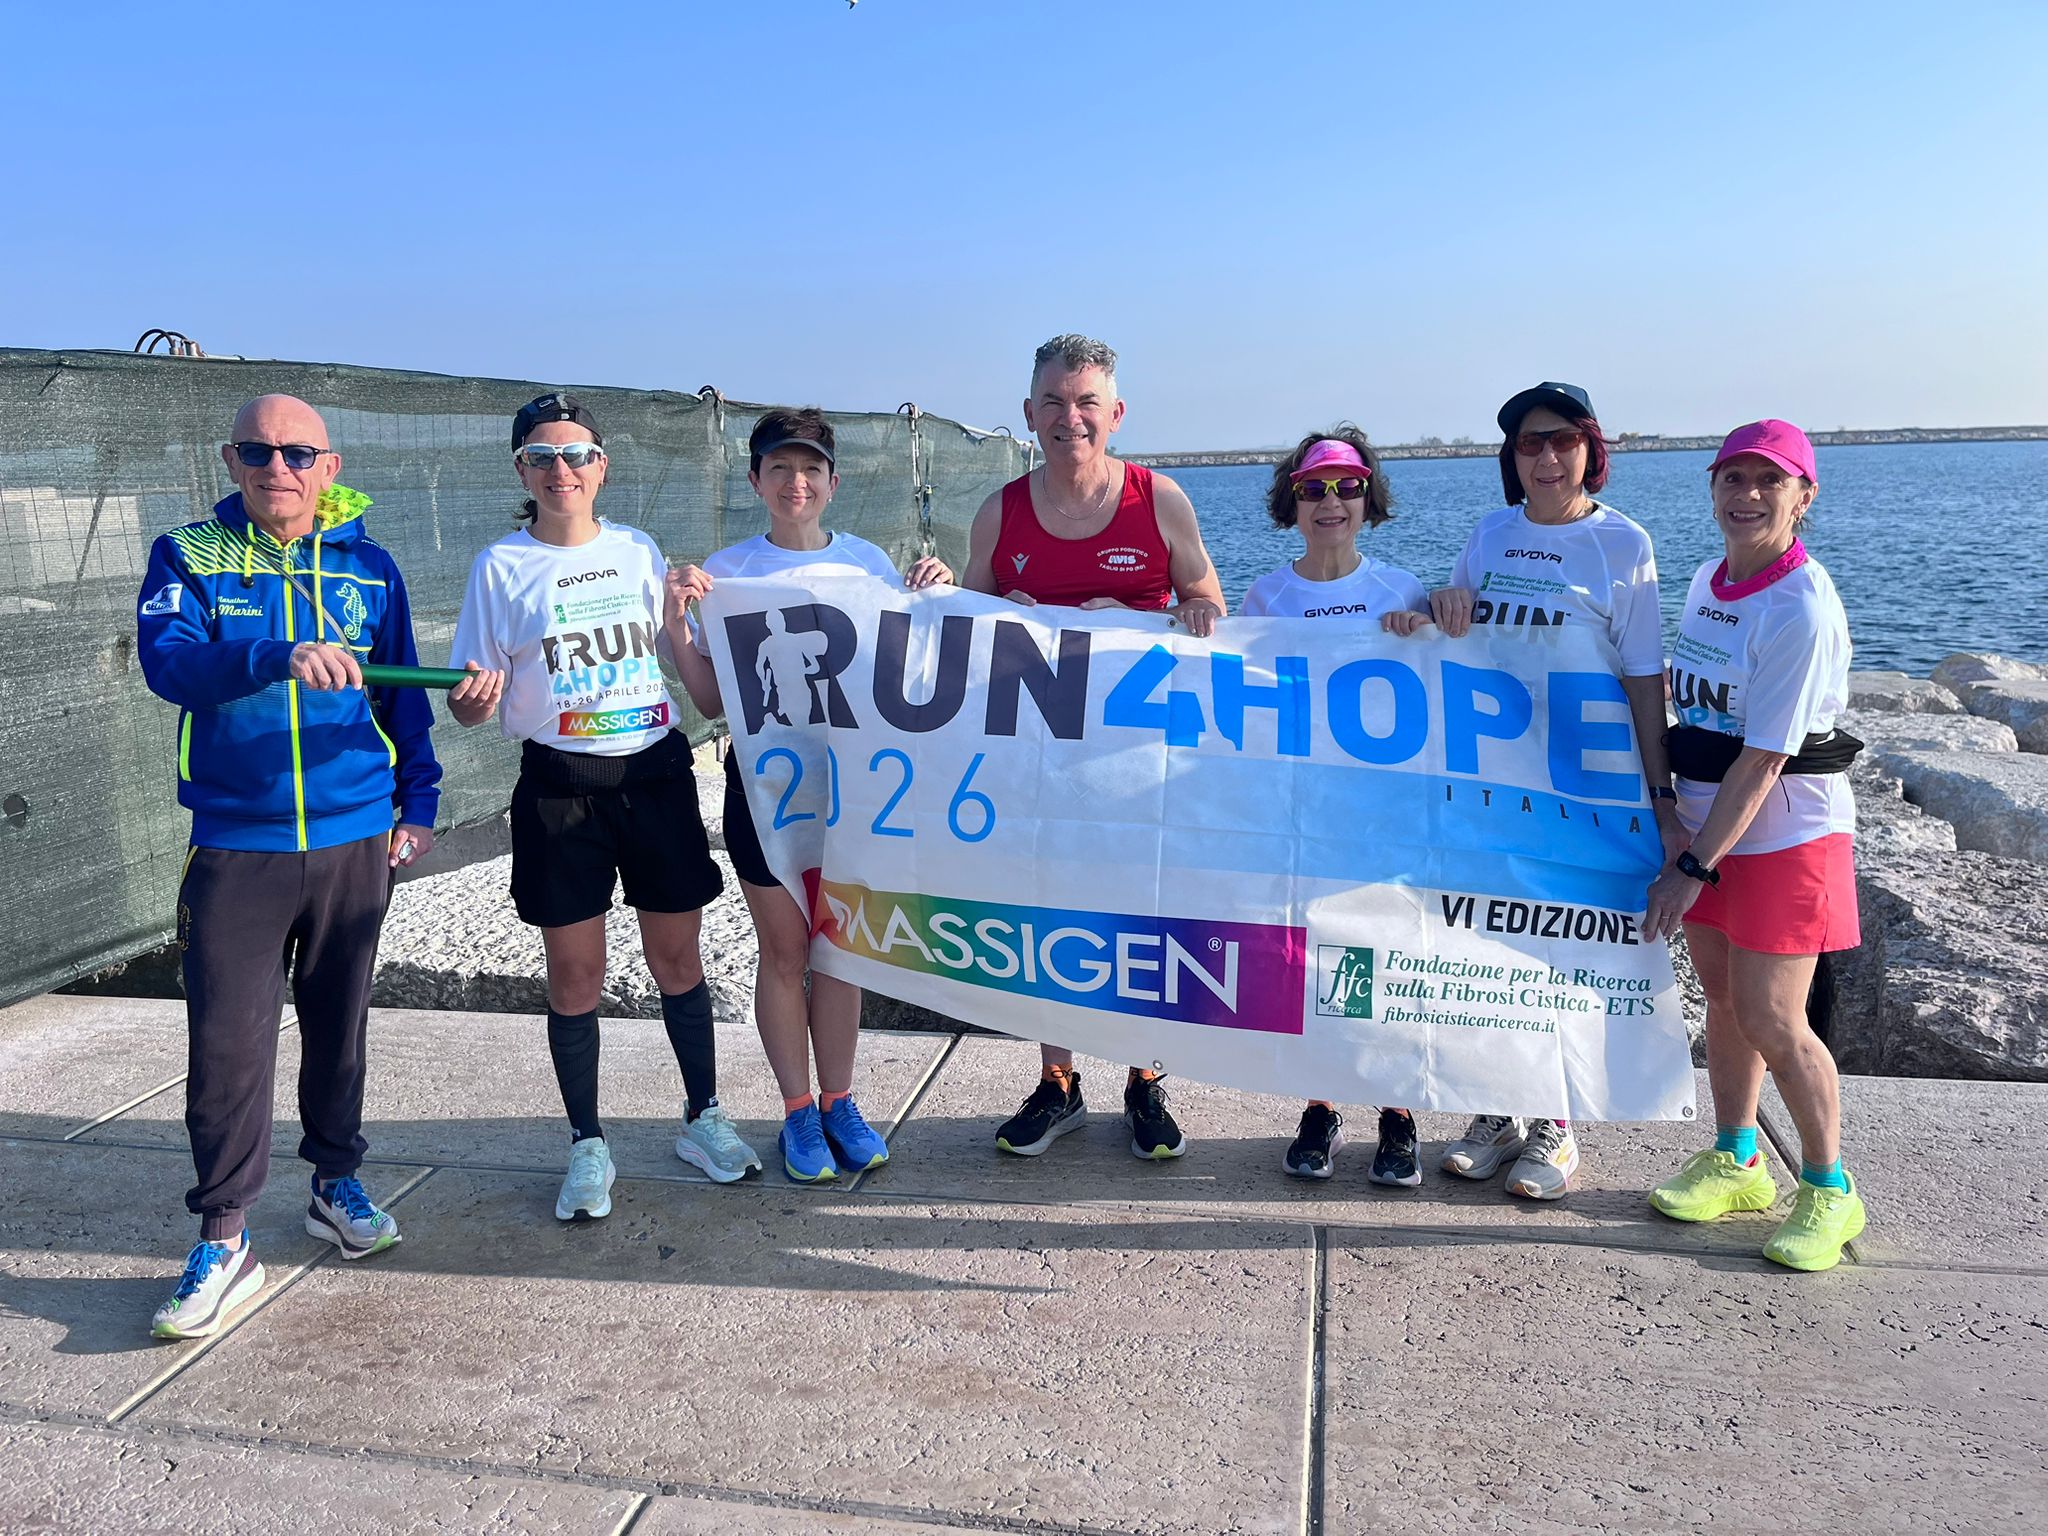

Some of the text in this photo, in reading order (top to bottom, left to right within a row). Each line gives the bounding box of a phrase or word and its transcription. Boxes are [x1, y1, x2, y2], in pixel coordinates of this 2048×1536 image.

[1097, 547, 1119, 557] GRUPPO
[1108, 555, 1137, 565] AVIS
[1504, 549, 1563, 564] GIVOVA
[557, 569, 618, 588] GIVOVA
[1099, 563, 1119, 571] TAGLIO
[218, 604, 264, 616] Marini
[1304, 604, 1367, 618] GIVOVA
[541, 621, 656, 675] RUN
[552, 656, 661, 696] 4HOPE
[556, 682, 664, 709] 18-26 APRILE 202
[1669, 664, 1730, 714] UN
[567, 708, 663, 732] MASSIGEN
[1441, 894, 1641, 946] VI EDIZIONE
[1384, 949, 1653, 993] Fondazione per la Ricerca
[1327, 1005, 1363, 1015] ricerca
[1383, 979, 1436, 999] sulla
[1439, 981, 1516, 1007] Fibrosi
[1519, 988, 1590, 1014] Cistica
[1604, 995, 1656, 1017] ETS
[1381, 1007, 1557, 1035] fibrosicisticaricerca.it
